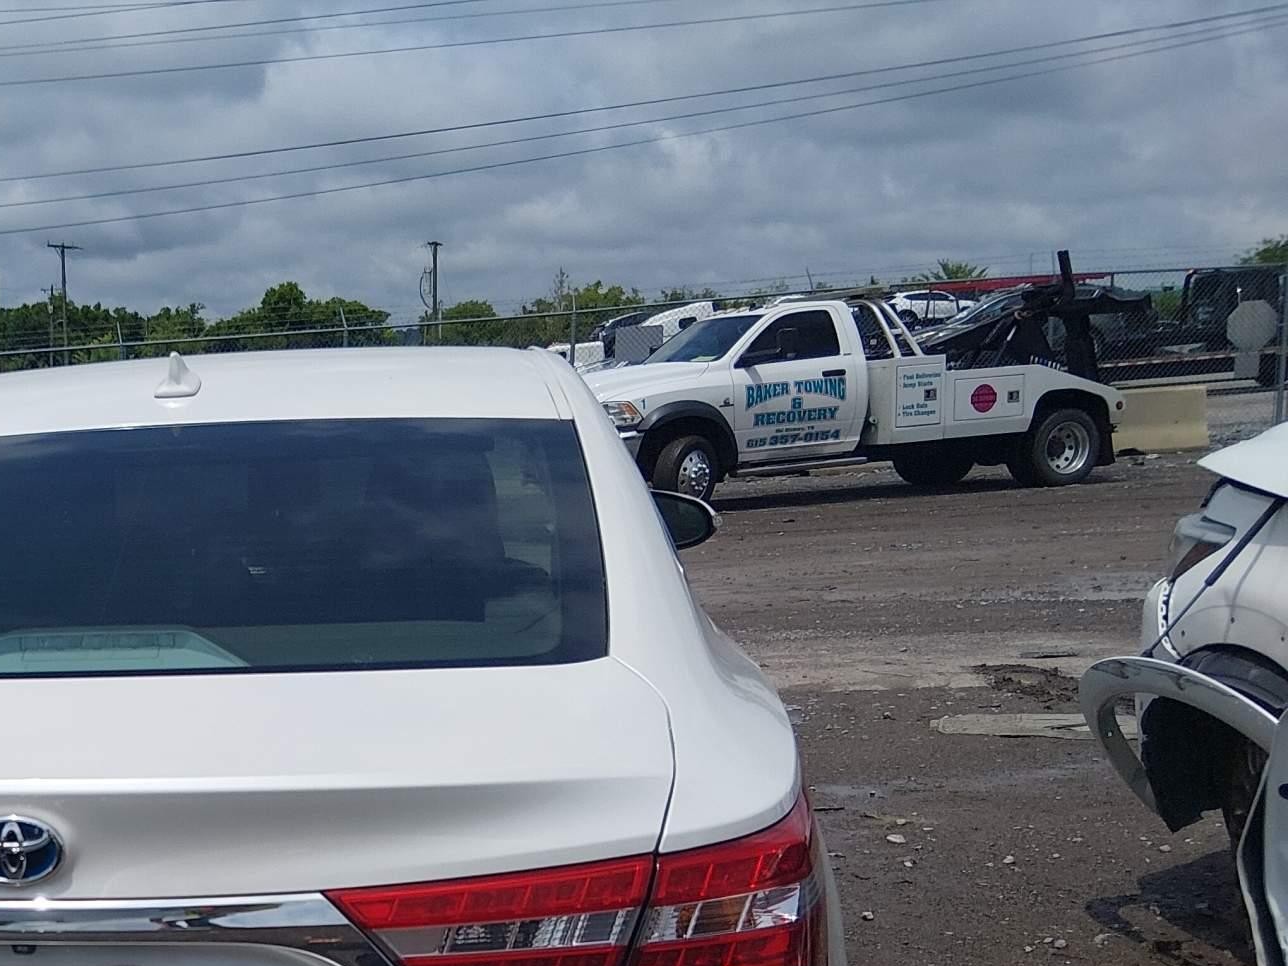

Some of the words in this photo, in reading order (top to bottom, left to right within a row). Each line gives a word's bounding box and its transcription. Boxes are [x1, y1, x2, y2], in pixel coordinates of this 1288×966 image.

[745, 382, 789, 411] BAKER
[794, 378, 846, 401] TOWING
[753, 406, 839, 427] RECOVERY
[746, 437, 767, 449] 615
[769, 429, 841, 446] 357-0154
